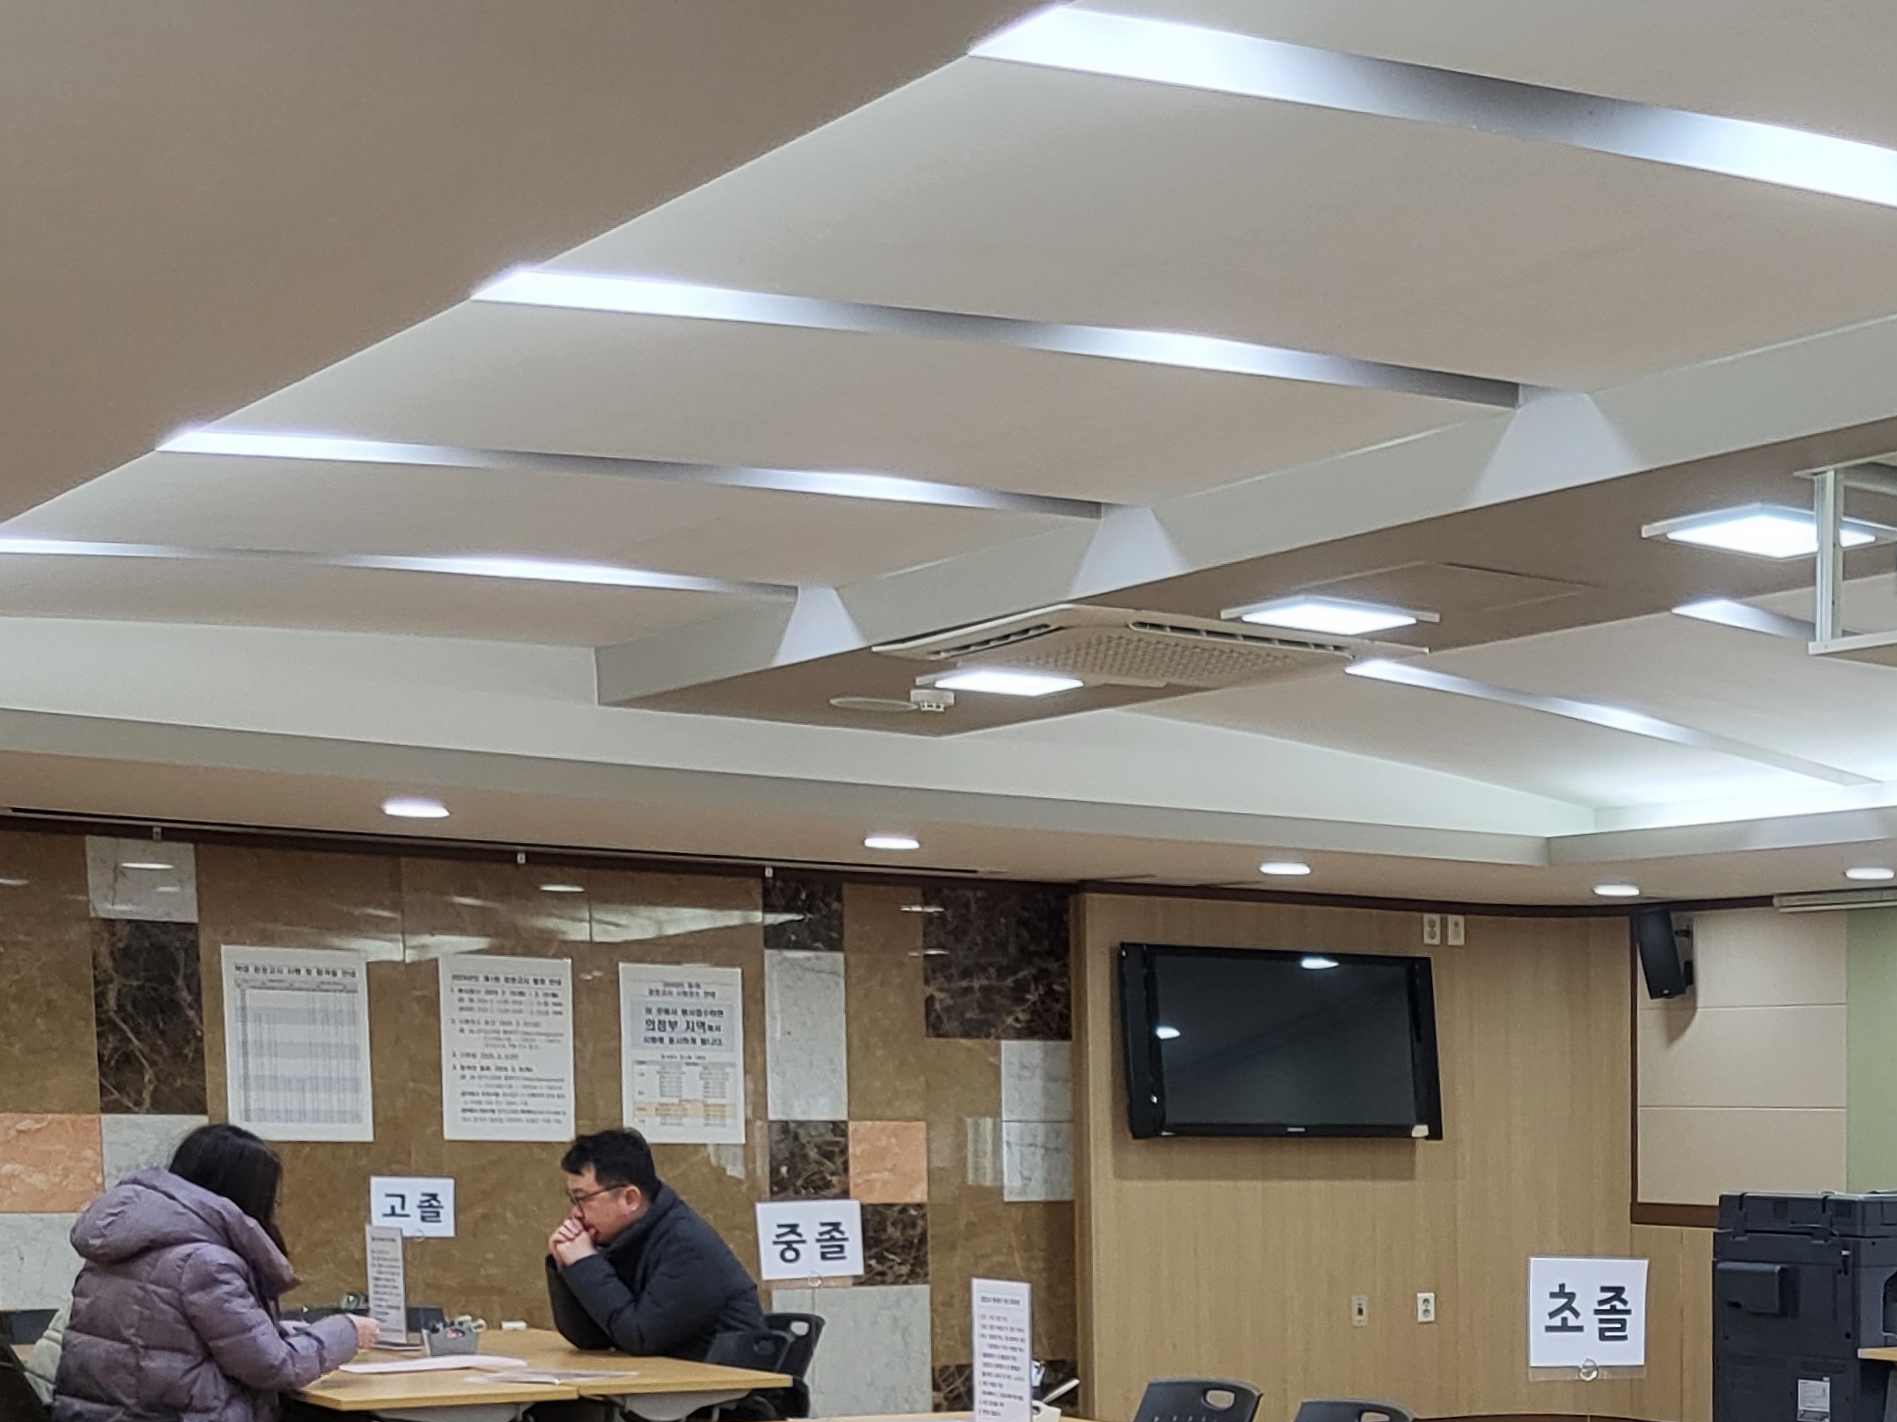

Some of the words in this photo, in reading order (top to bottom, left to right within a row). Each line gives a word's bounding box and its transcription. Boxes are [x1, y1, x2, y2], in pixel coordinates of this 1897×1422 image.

[645, 1019, 678, 1032] 의정부
[382, 1192, 444, 1223] 고졸
[772, 1222, 849, 1263] 중졸
[1544, 1283, 1632, 1341] 초졸
